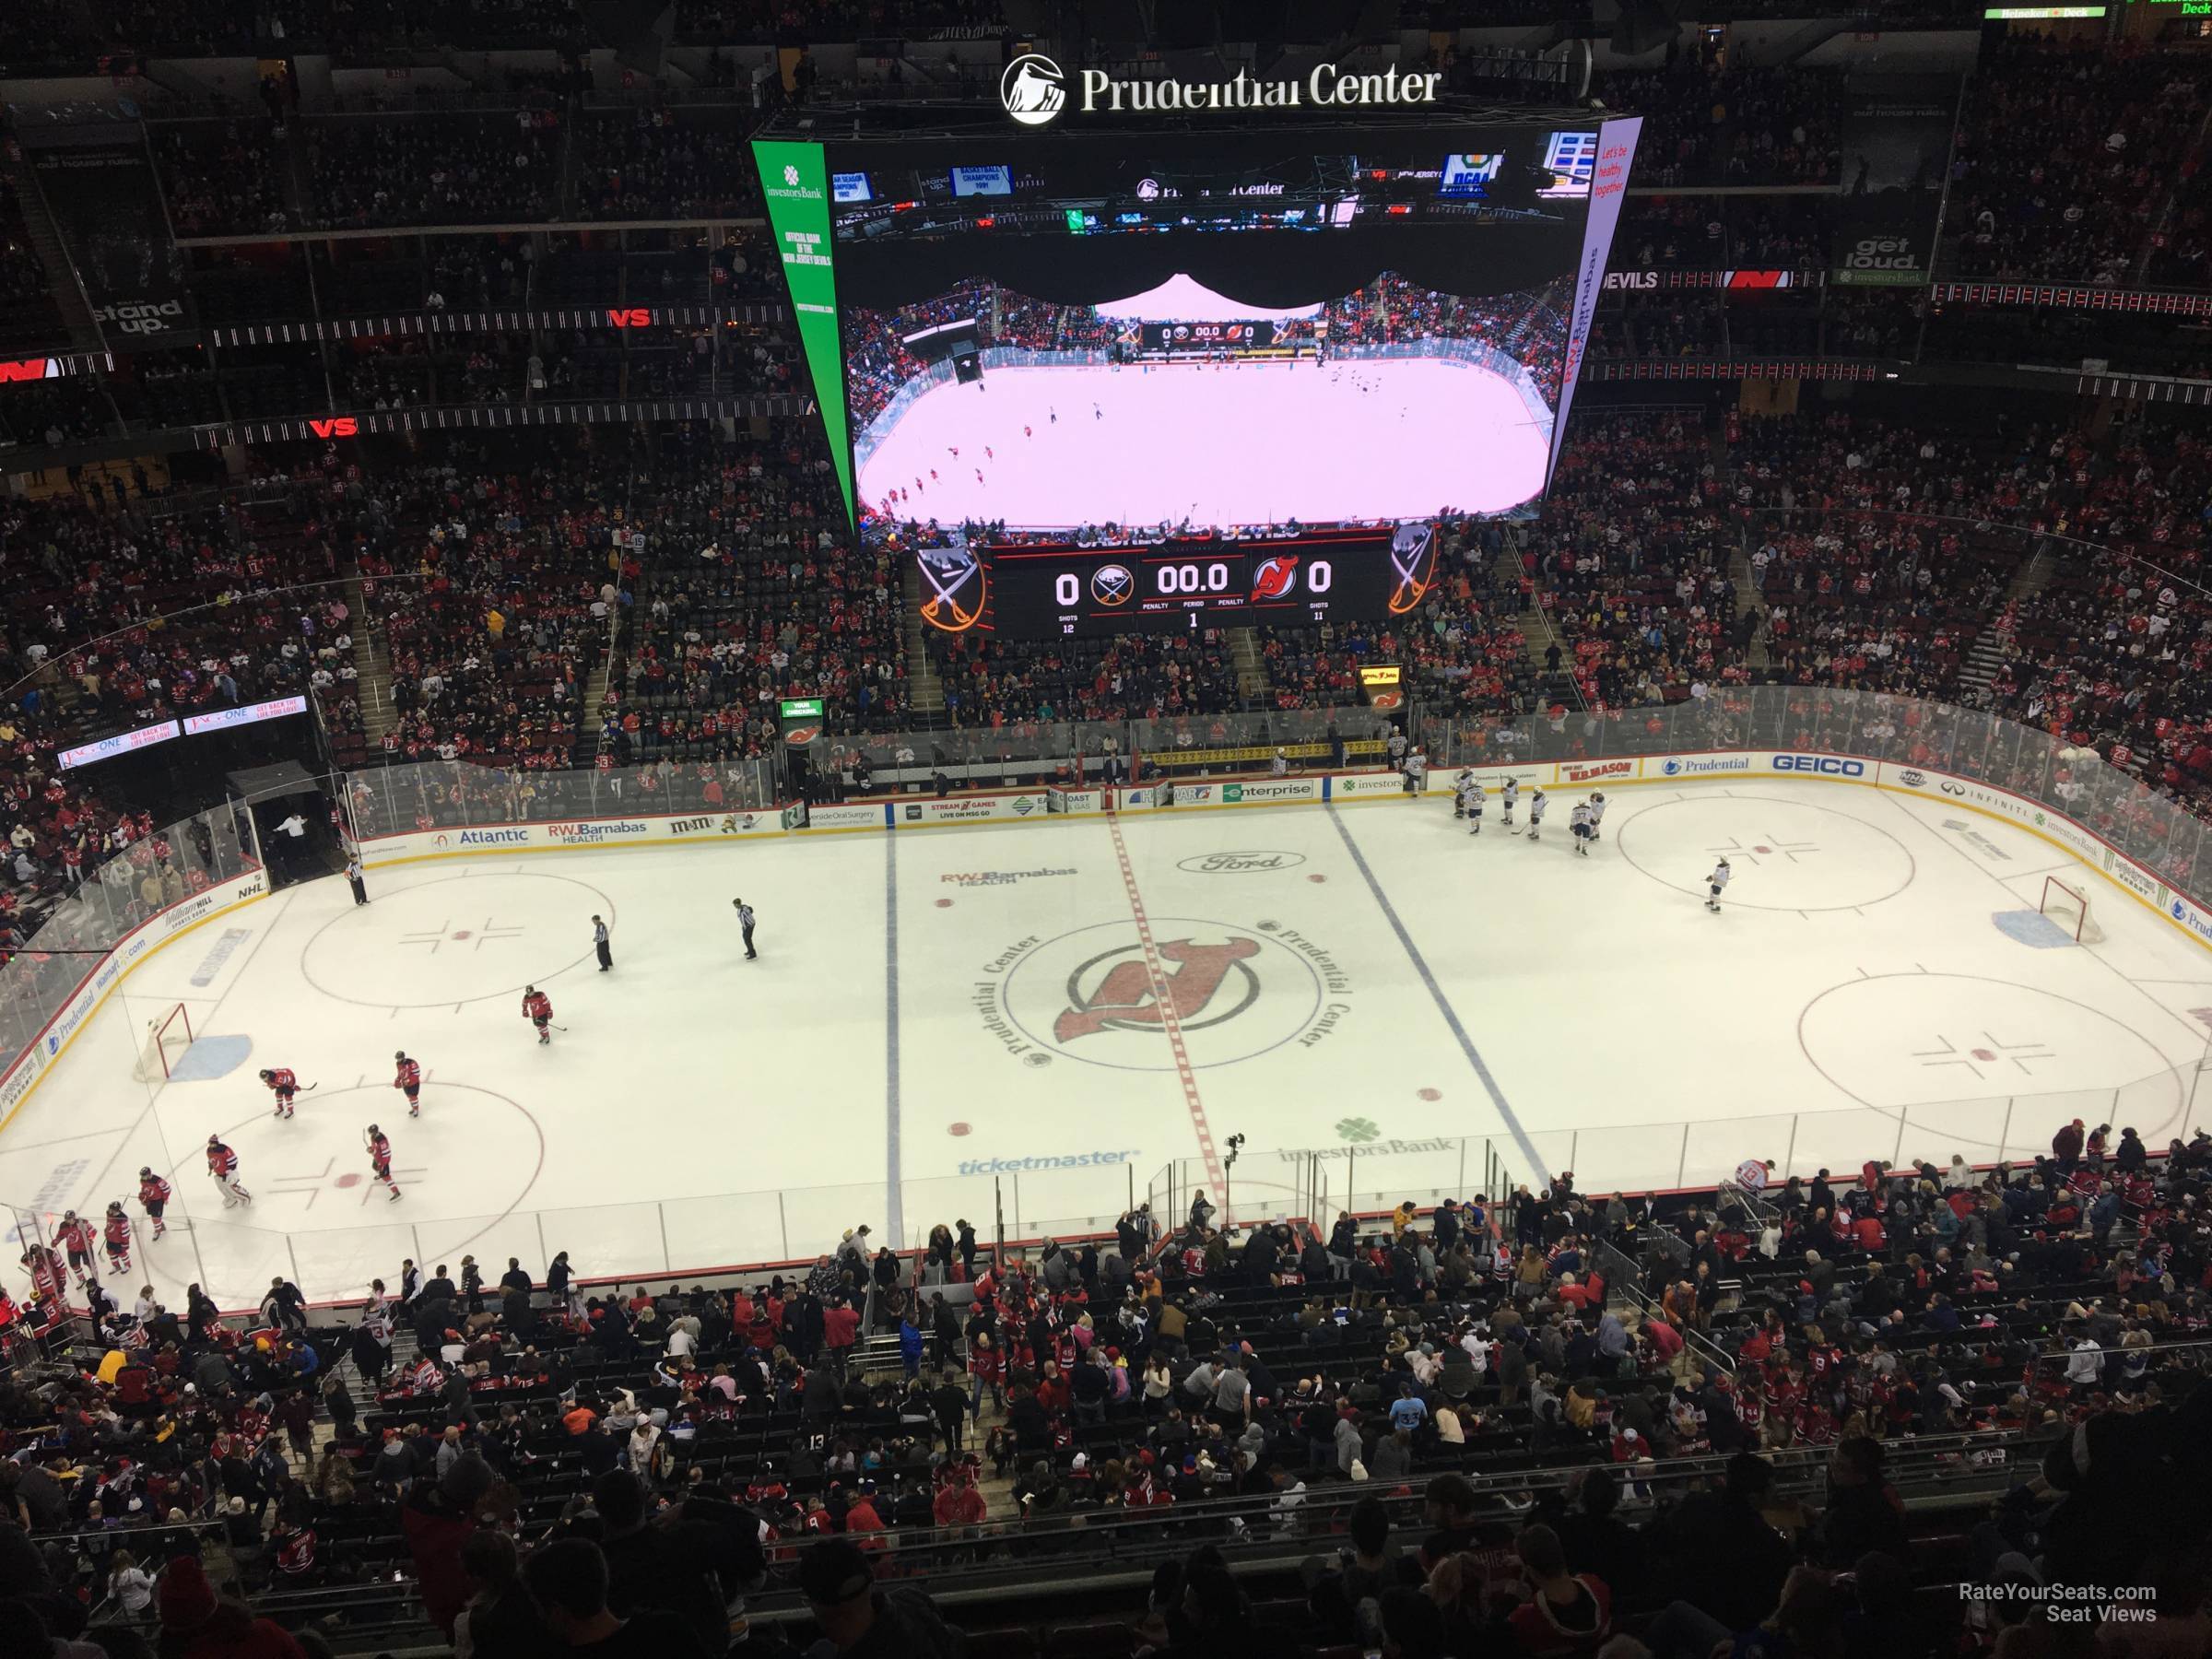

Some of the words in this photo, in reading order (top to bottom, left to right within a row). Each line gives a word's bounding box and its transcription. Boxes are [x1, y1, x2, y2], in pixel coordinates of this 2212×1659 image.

[2001, 8, 2049, 18] Heineken
[2063, 8, 2088, 18] Deck
[2182, 3, 2211, 15] Deck
[1080, 66, 1301, 111] Prudential
[1310, 63, 1442, 105] Center
[62, 159, 104, 169] house
[1598, 164, 1622, 180] healthy
[962, 173, 1000, 182] CHAMPIONS
[767, 185, 823, 199] investorsBank
[785, 231, 806, 242] OFFICIAL
[806, 233, 821, 244] BANK
[1856, 237, 1911, 256] get
[814, 255, 831, 266] DEVILS
[1845, 253, 1921, 269] loud.
[93, 300, 183, 323] stand
[609, 309, 652, 327] VS
[120, 314, 171, 335] up.
[309, 417, 359, 438] VS
[1055, 573, 1079, 606] 0
[1158, 563, 1228, 594] 00.0
[1309, 560, 1332, 593] 0
[1143, 602, 1169, 610] PENALTY
[1218, 598, 1244, 606] PENALTY
[1190, 612, 1197, 628] 1
[1313, 611, 1324, 620] 11
[1063, 624, 1075, 634] 12
[225, 708, 248, 720] ONE
[256, 704, 267, 713] GET
[268, 700, 285, 712] BACK
[286, 699, 297, 708] THE
[256, 711, 268, 719] LIFE
[269, 708, 282, 717] YOU
[130, 731, 141, 741] GET
[142, 725, 159, 737] BACK
[159, 722, 171, 734] THE
[143, 734, 156, 744] YOU
[99, 738, 122, 751] ONE
[1686, 758, 1749, 771] Prudential
[1772, 755, 1864, 776] GEICO
[1900, 771, 1926, 782] NHL
[931, 802, 960, 811] STREAM
[1970, 790, 2028, 817] INFINITI
[460, 828, 529, 844] Atlantic
[548, 820, 647, 838] RWJBarnabas
[563, 834, 604, 844] HEALTH
[2047, 818, 2100, 857] investorsBank
[1200, 853, 1283, 872] Ford
[940, 866, 1078, 883] RWJBarnabas
[959, 877, 1017, 888] HEALTH
[982, 935, 1041, 974] Center
[1277, 929, 1354, 994] Prudential
[96, 959, 121, 990] Walmart
[59, 991, 95, 1041] Prudential
[971, 982, 1032, 1055] Prudential
[1298, 1003, 1351, 1048] Center
[1277, 1135, 1455, 1164] investorsBank
[958, 1150, 1131, 1176] ticketmaster
[1194, 1257, 1203, 1271] 4
[46, 1305, 57, 1320] 13
[1816, 1357, 1825, 1371] 9
[810, 1434, 824, 1450] 13
[297, 1545, 308, 1563] 4
